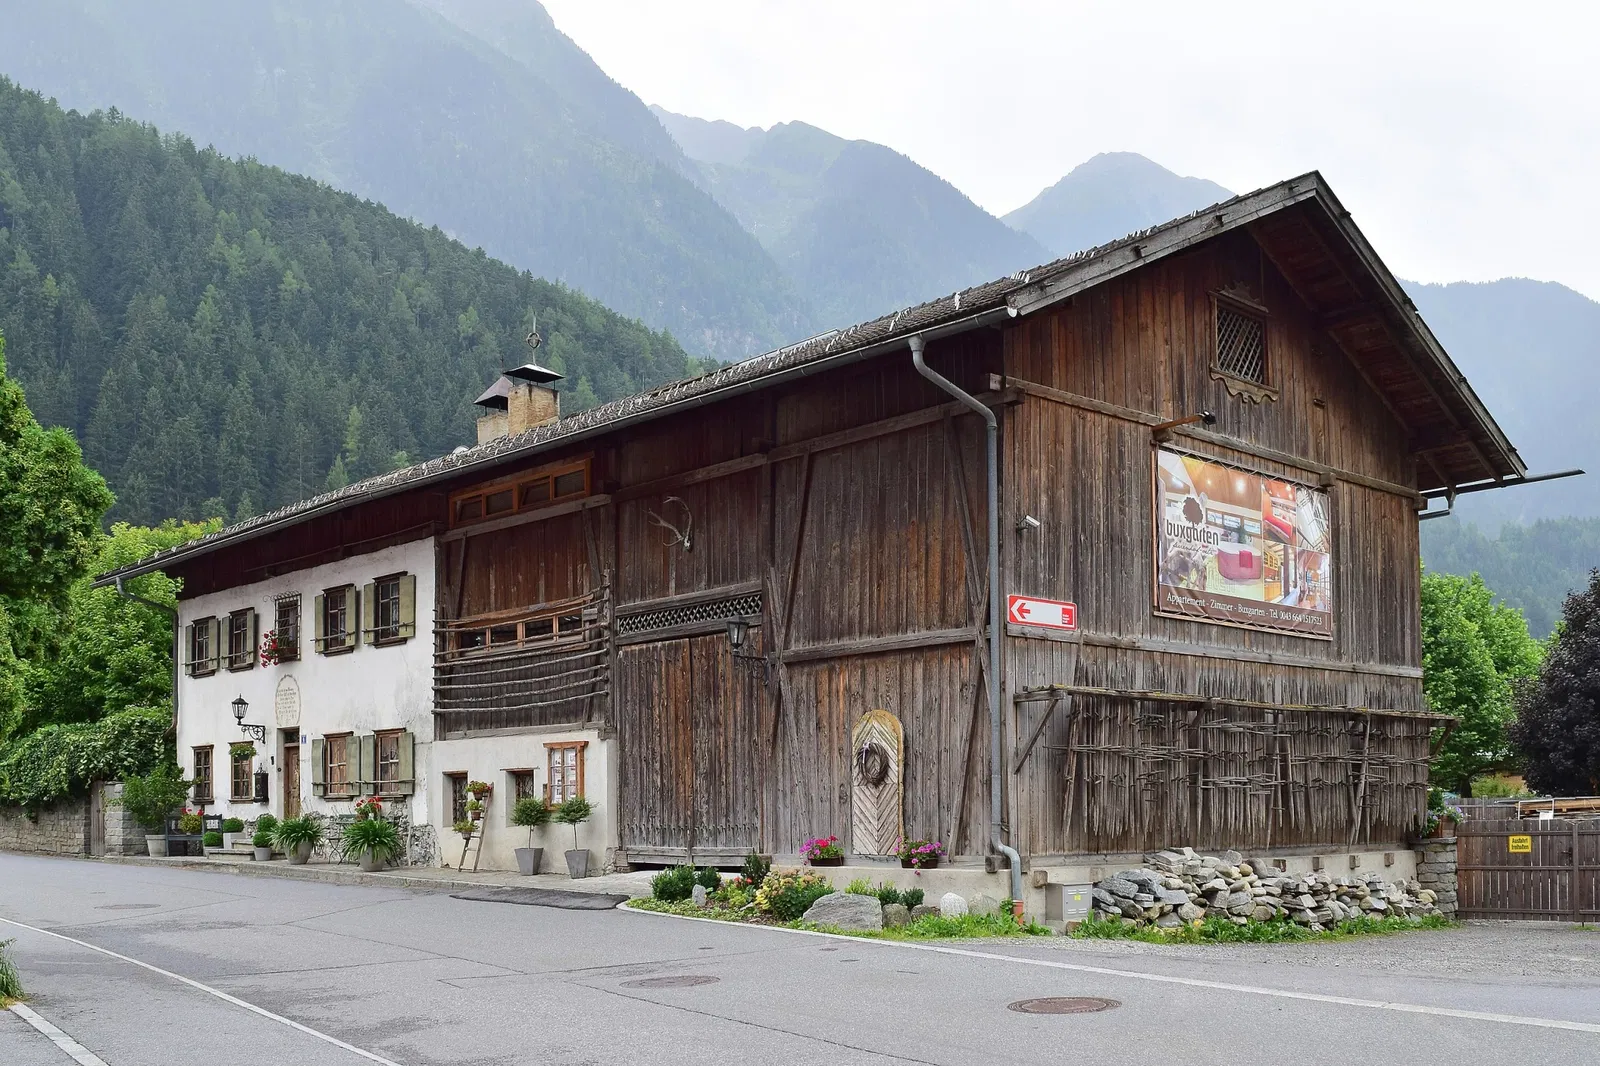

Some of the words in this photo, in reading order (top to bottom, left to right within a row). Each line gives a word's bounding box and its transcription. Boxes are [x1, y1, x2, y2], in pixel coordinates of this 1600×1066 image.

[1166, 519, 1219, 546] buxgarten
[1167, 592, 1205, 607] Appartement
[1210, 599, 1233, 611] Zimmer
